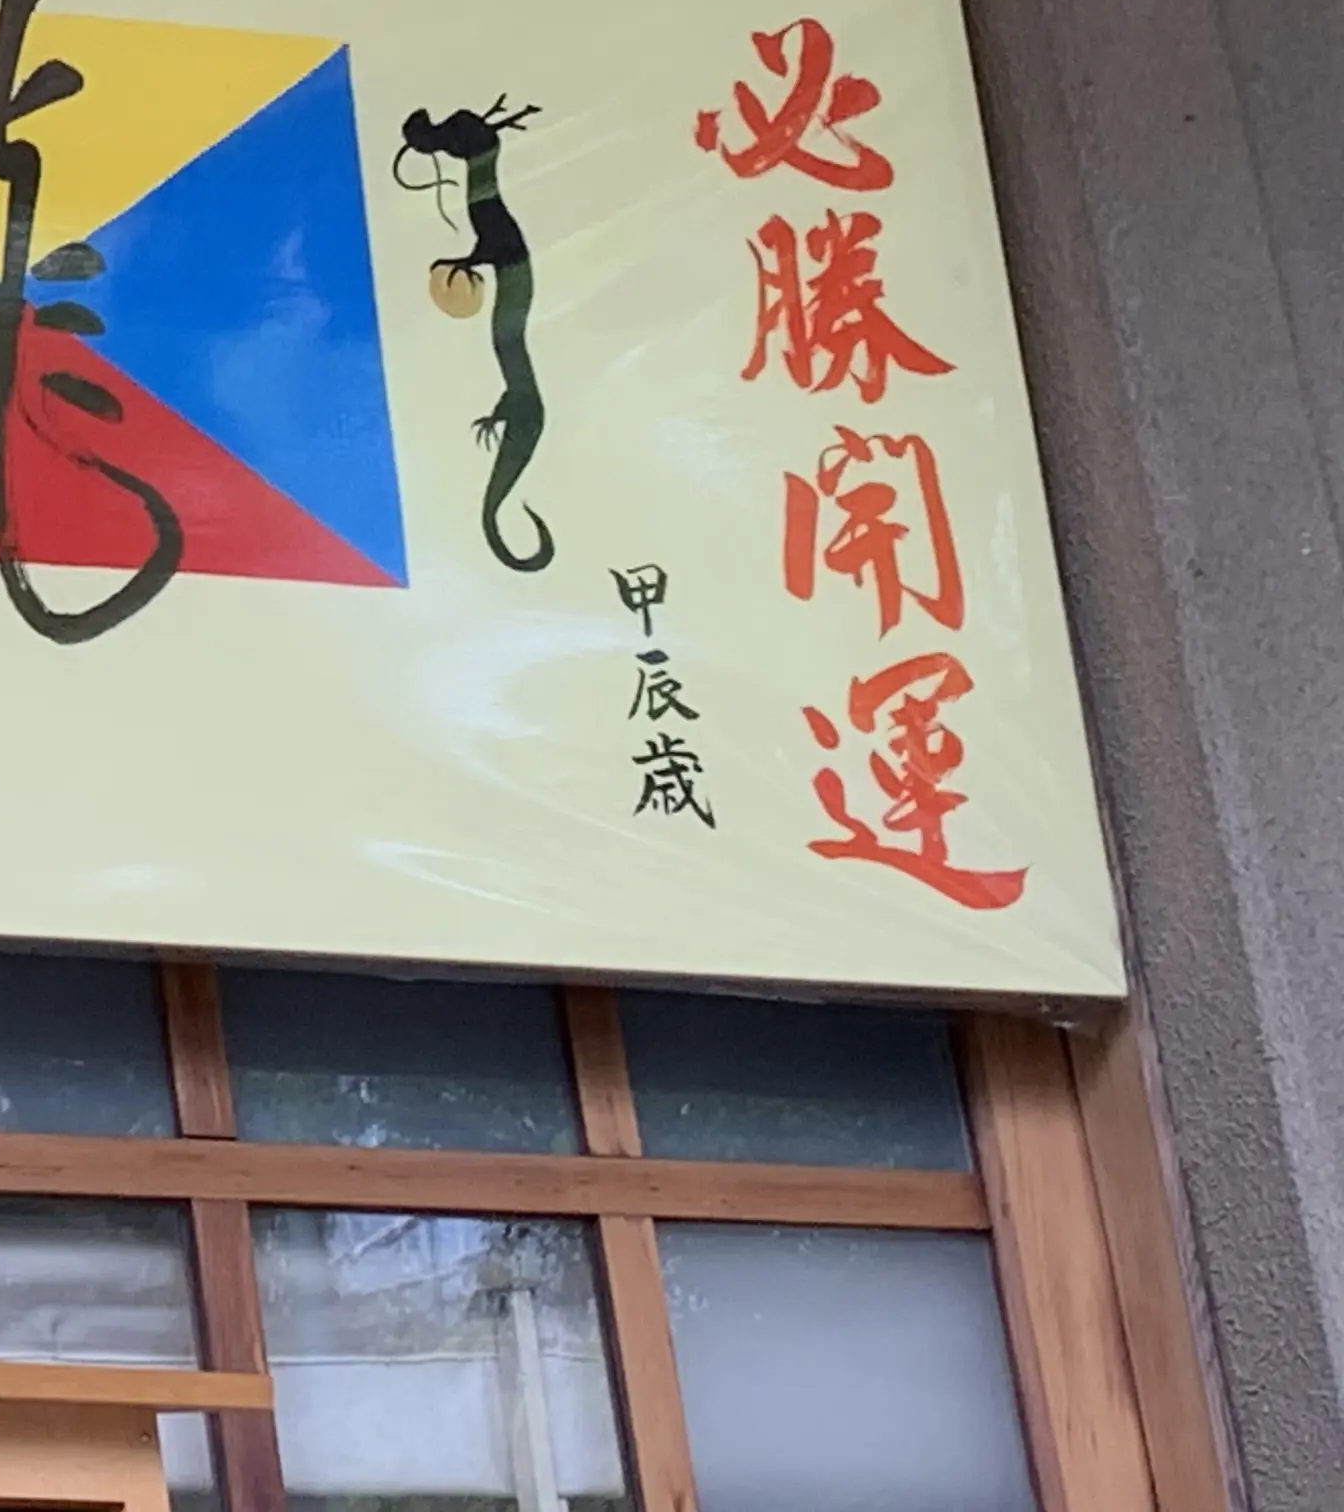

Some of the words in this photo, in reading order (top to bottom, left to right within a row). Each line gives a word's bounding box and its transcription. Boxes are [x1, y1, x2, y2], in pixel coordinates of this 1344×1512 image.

[609, 563, 715, 829] 甲辰歳
[694, 18, 1030, 910] 必勝開運
